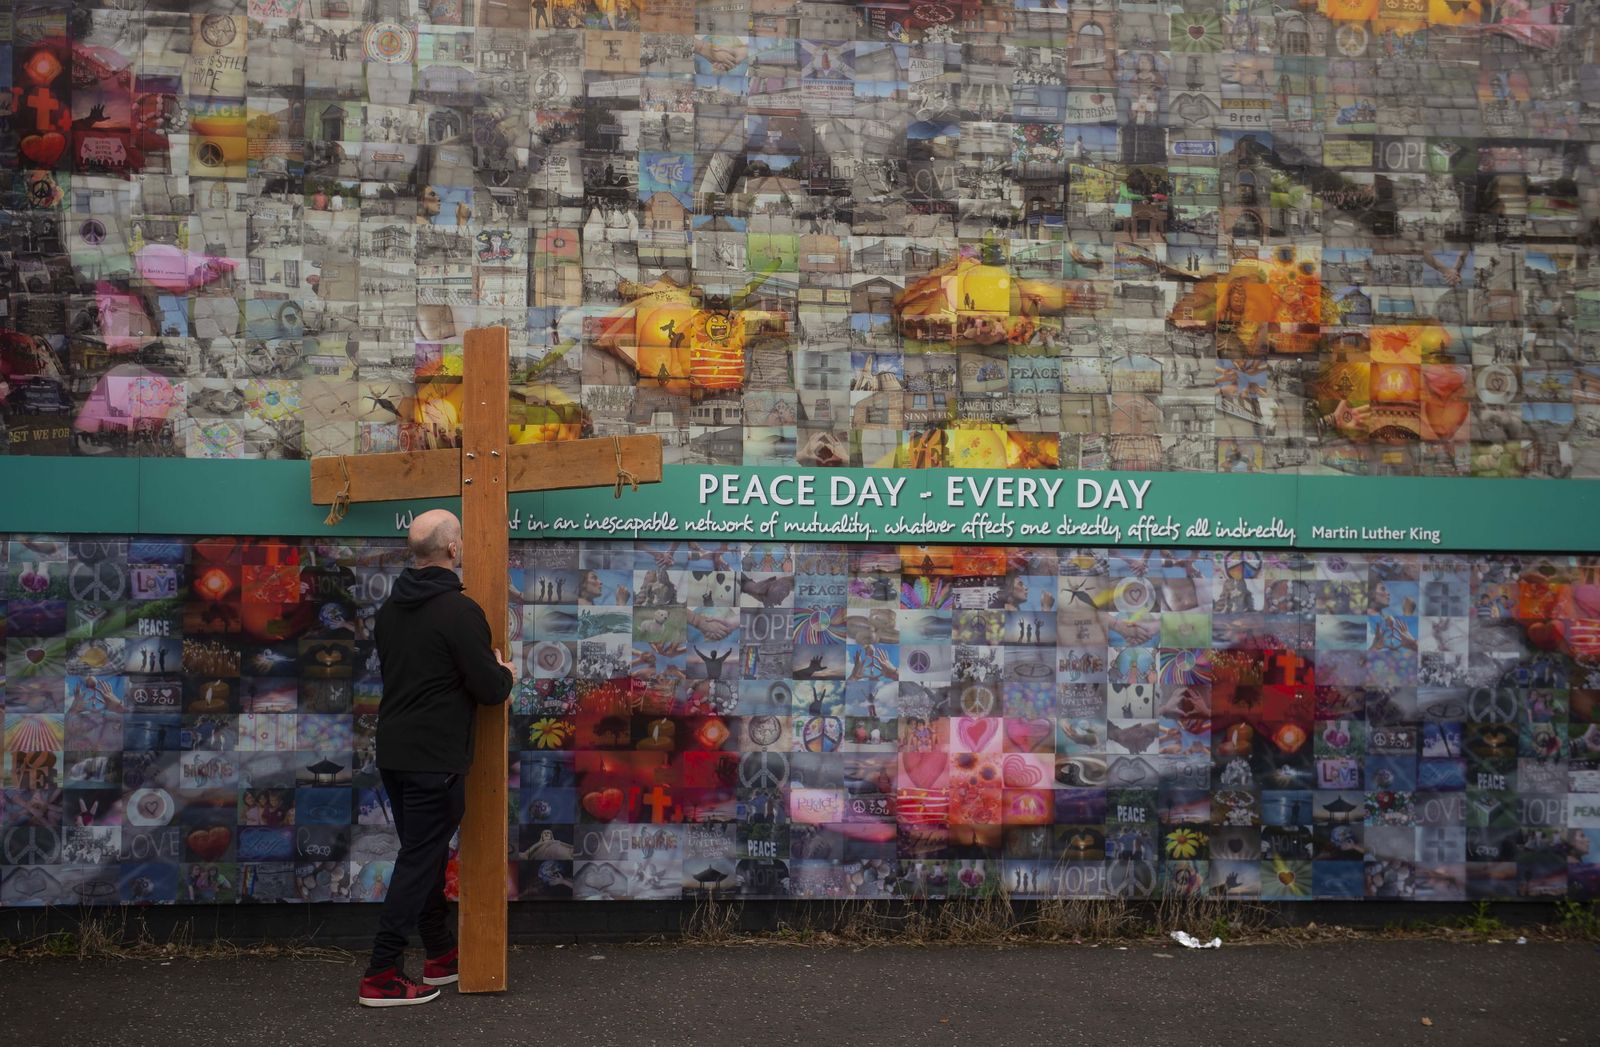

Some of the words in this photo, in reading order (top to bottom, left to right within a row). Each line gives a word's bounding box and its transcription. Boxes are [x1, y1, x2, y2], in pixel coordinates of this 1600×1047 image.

[216, 54, 248, 73] STILL
[1229, 112, 1262, 123] Bred
[1010, 366, 1060, 379] PEACE
[957, 400, 1006, 412] CAVENDISH
[904, 411, 928, 421] SINN
[961, 412, 995, 422] SQUARE
[33, 429, 50, 440] WE
[700, 473, 815, 506] PEACE
[830, 475, 906, 507] DAY
[947, 476, 1063, 508] EVERY
[1077, 478, 1151, 509] DAY
[528, 514, 550, 531] in
[553, 516, 579, 531] an
[585, 511, 678, 539] inescapable
[685, 509, 753, 533] network
[760, 511, 779, 538] of
[885, 511, 955, 535] whatever
[962, 512, 1014, 539] affects
[1021, 522, 1051, 536] one
[1128, 515, 1180, 543] affects
[1186, 518, 1211, 537] all
[1312, 525, 1357, 540] Martin
[1362, 526, 1406, 541] Luther
[1410, 527, 1441, 544] King
[136, 570, 176, 594] LOVE
[799, 584, 845, 596] PEACE
[138, 617, 169, 637] PEACE
[740, 614, 794, 640] HOPE
[152, 696, 174, 706] YOU
[1389, 740, 1410, 748] YOU
[1323, 763, 1357, 783] LOVE
[1477, 772, 1505, 791] PEACE
[869, 806, 889, 815] YOU
[1117, 805, 1146, 823] PEACE
[747, 840, 777, 858] PEACE
